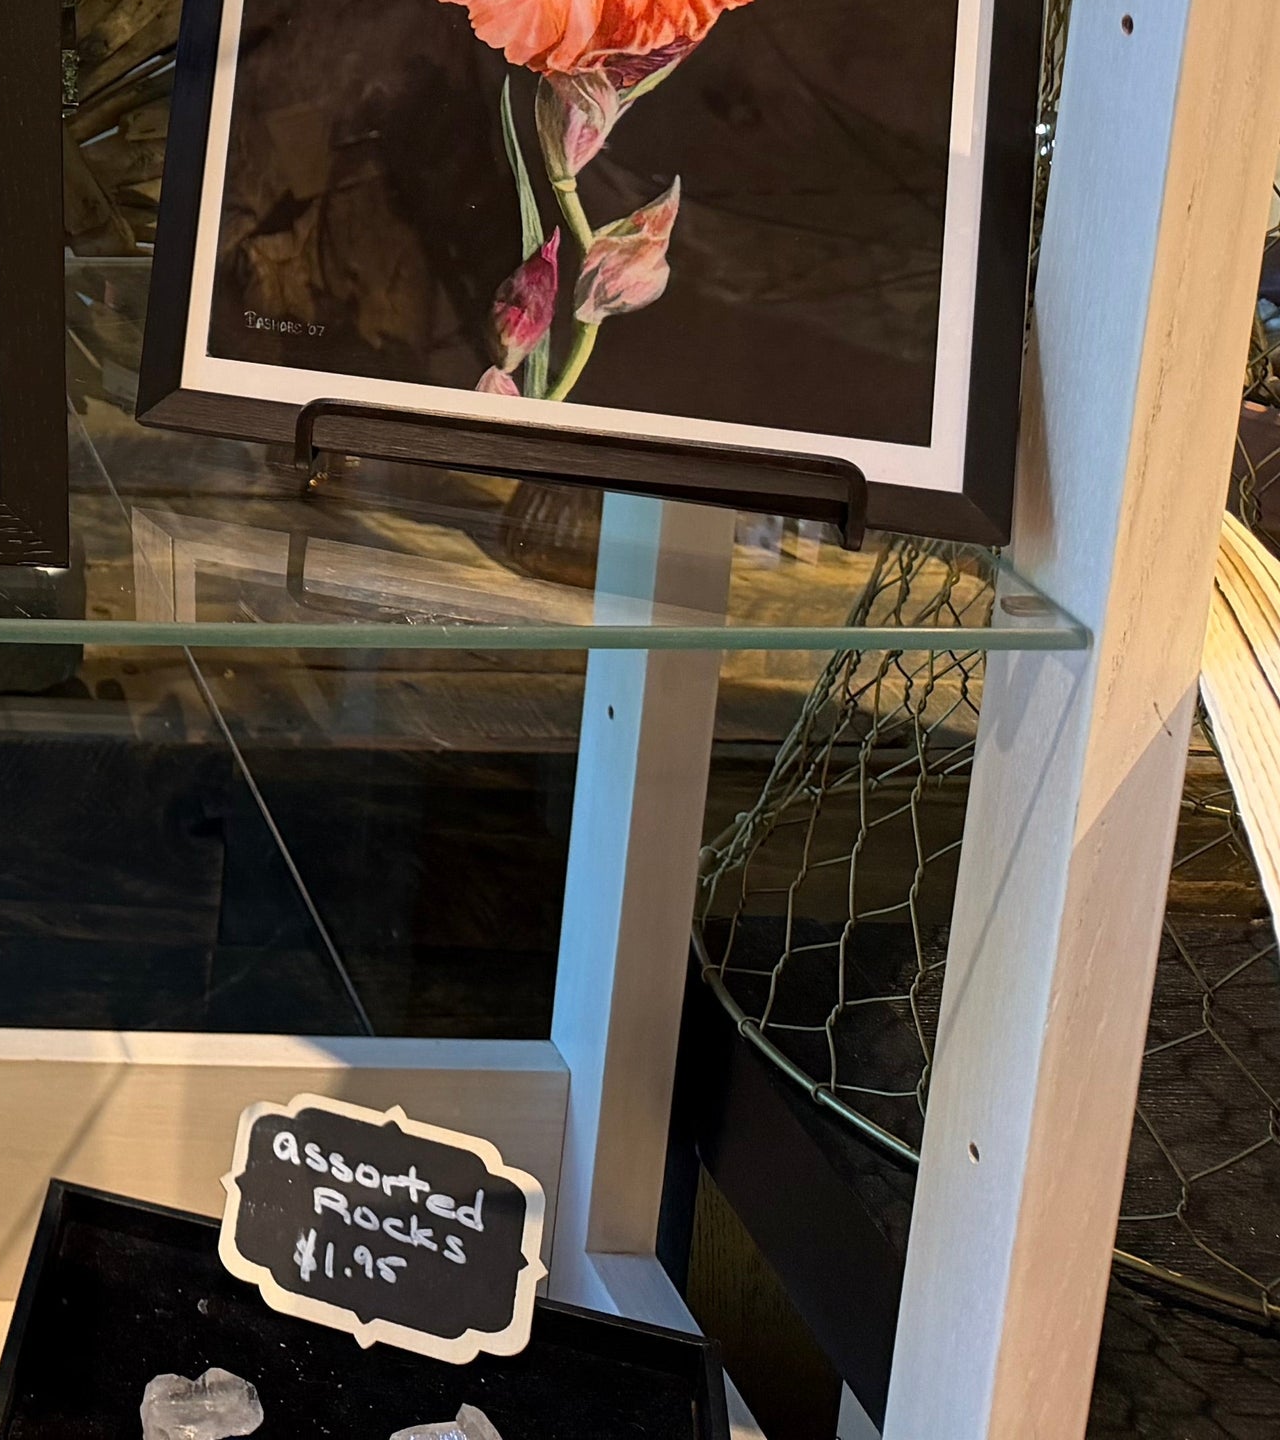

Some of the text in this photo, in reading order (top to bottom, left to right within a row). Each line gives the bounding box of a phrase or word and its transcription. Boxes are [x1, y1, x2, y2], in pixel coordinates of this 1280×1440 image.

[272, 1131, 484, 1232] assorted
[293, 1228, 408, 1283] $1.95
[313, 1186, 467, 1264] Rocks
